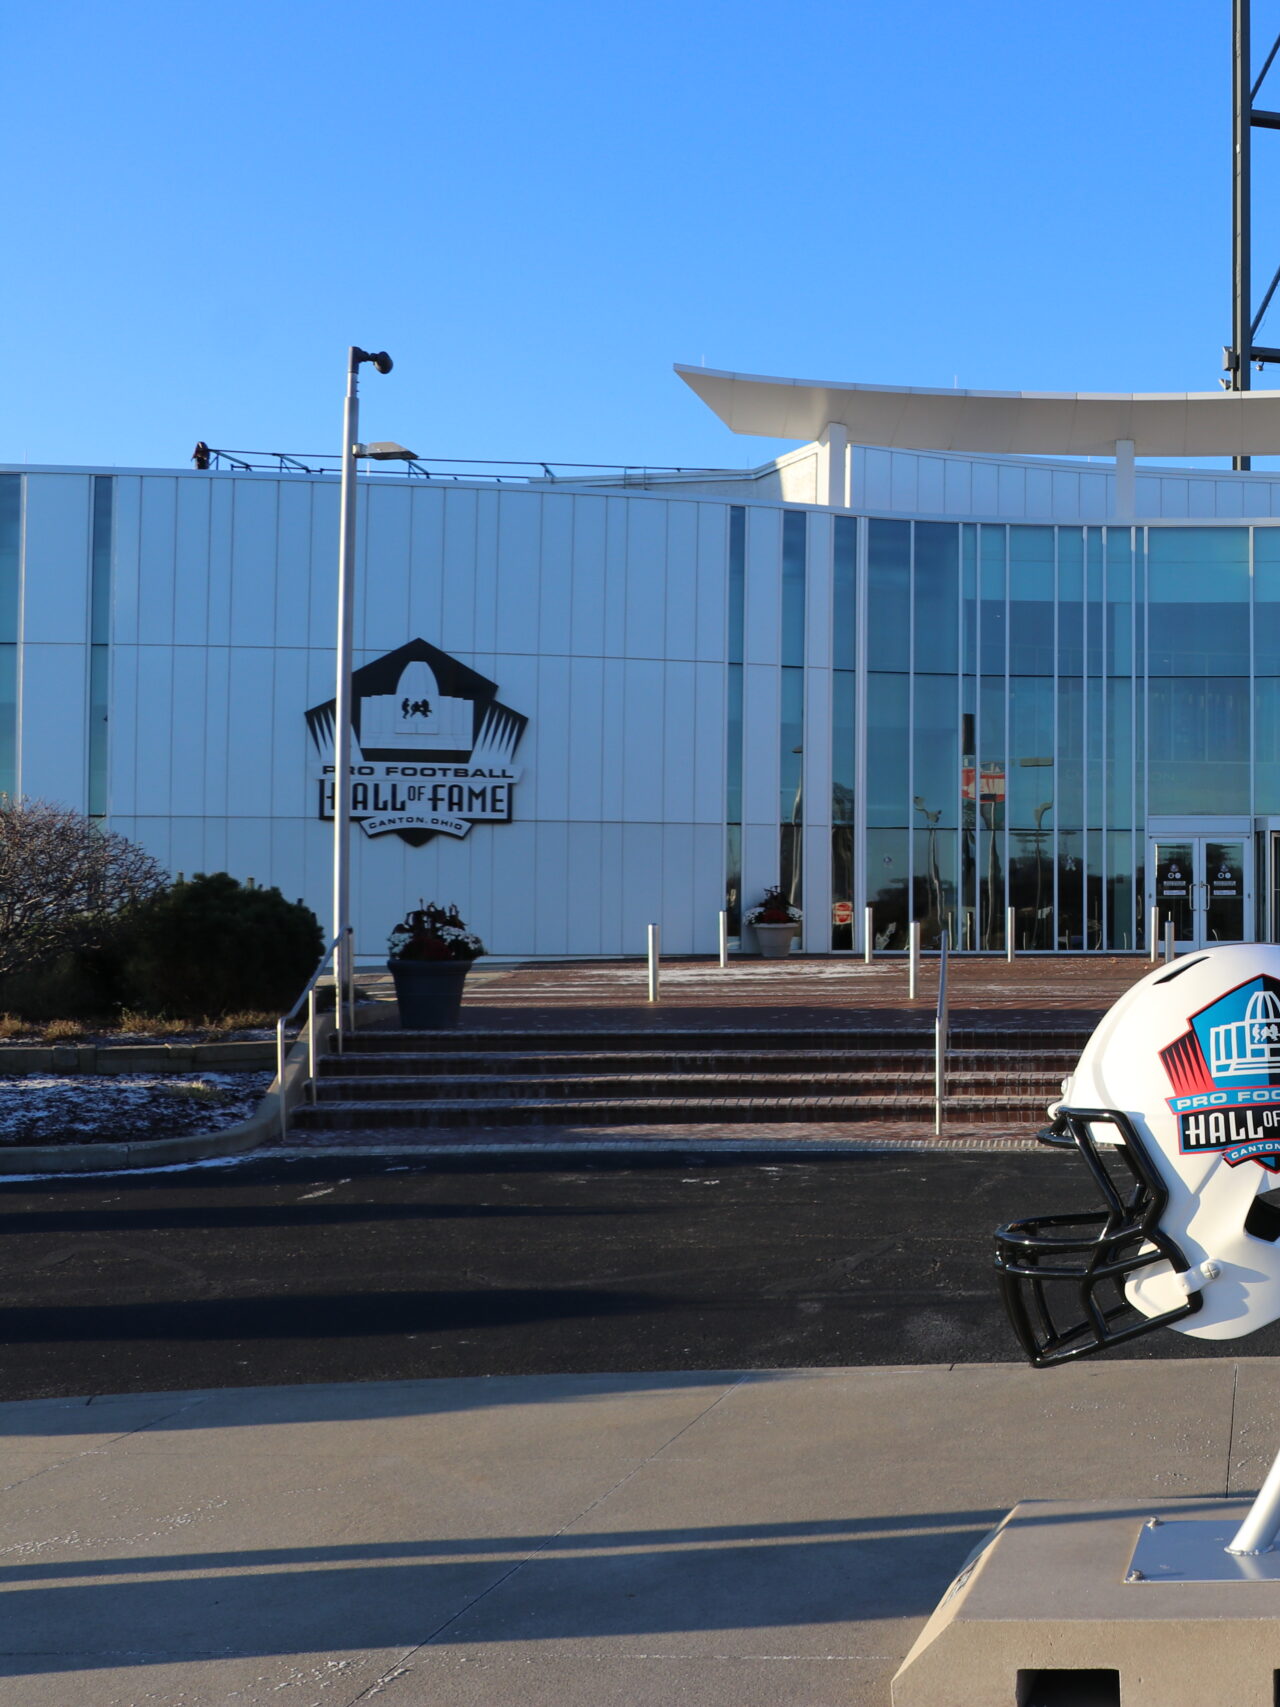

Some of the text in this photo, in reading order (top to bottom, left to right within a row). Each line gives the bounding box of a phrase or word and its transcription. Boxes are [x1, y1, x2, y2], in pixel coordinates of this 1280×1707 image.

[385, 766, 514, 779] FOOTBALL
[408, 785, 426, 802] OF
[428, 783, 505, 814] FAME
[431, 818, 463, 831] OHIO
[1177, 1092, 1228, 1110] PRO
[1185, 1111, 1264, 1146] HALL
